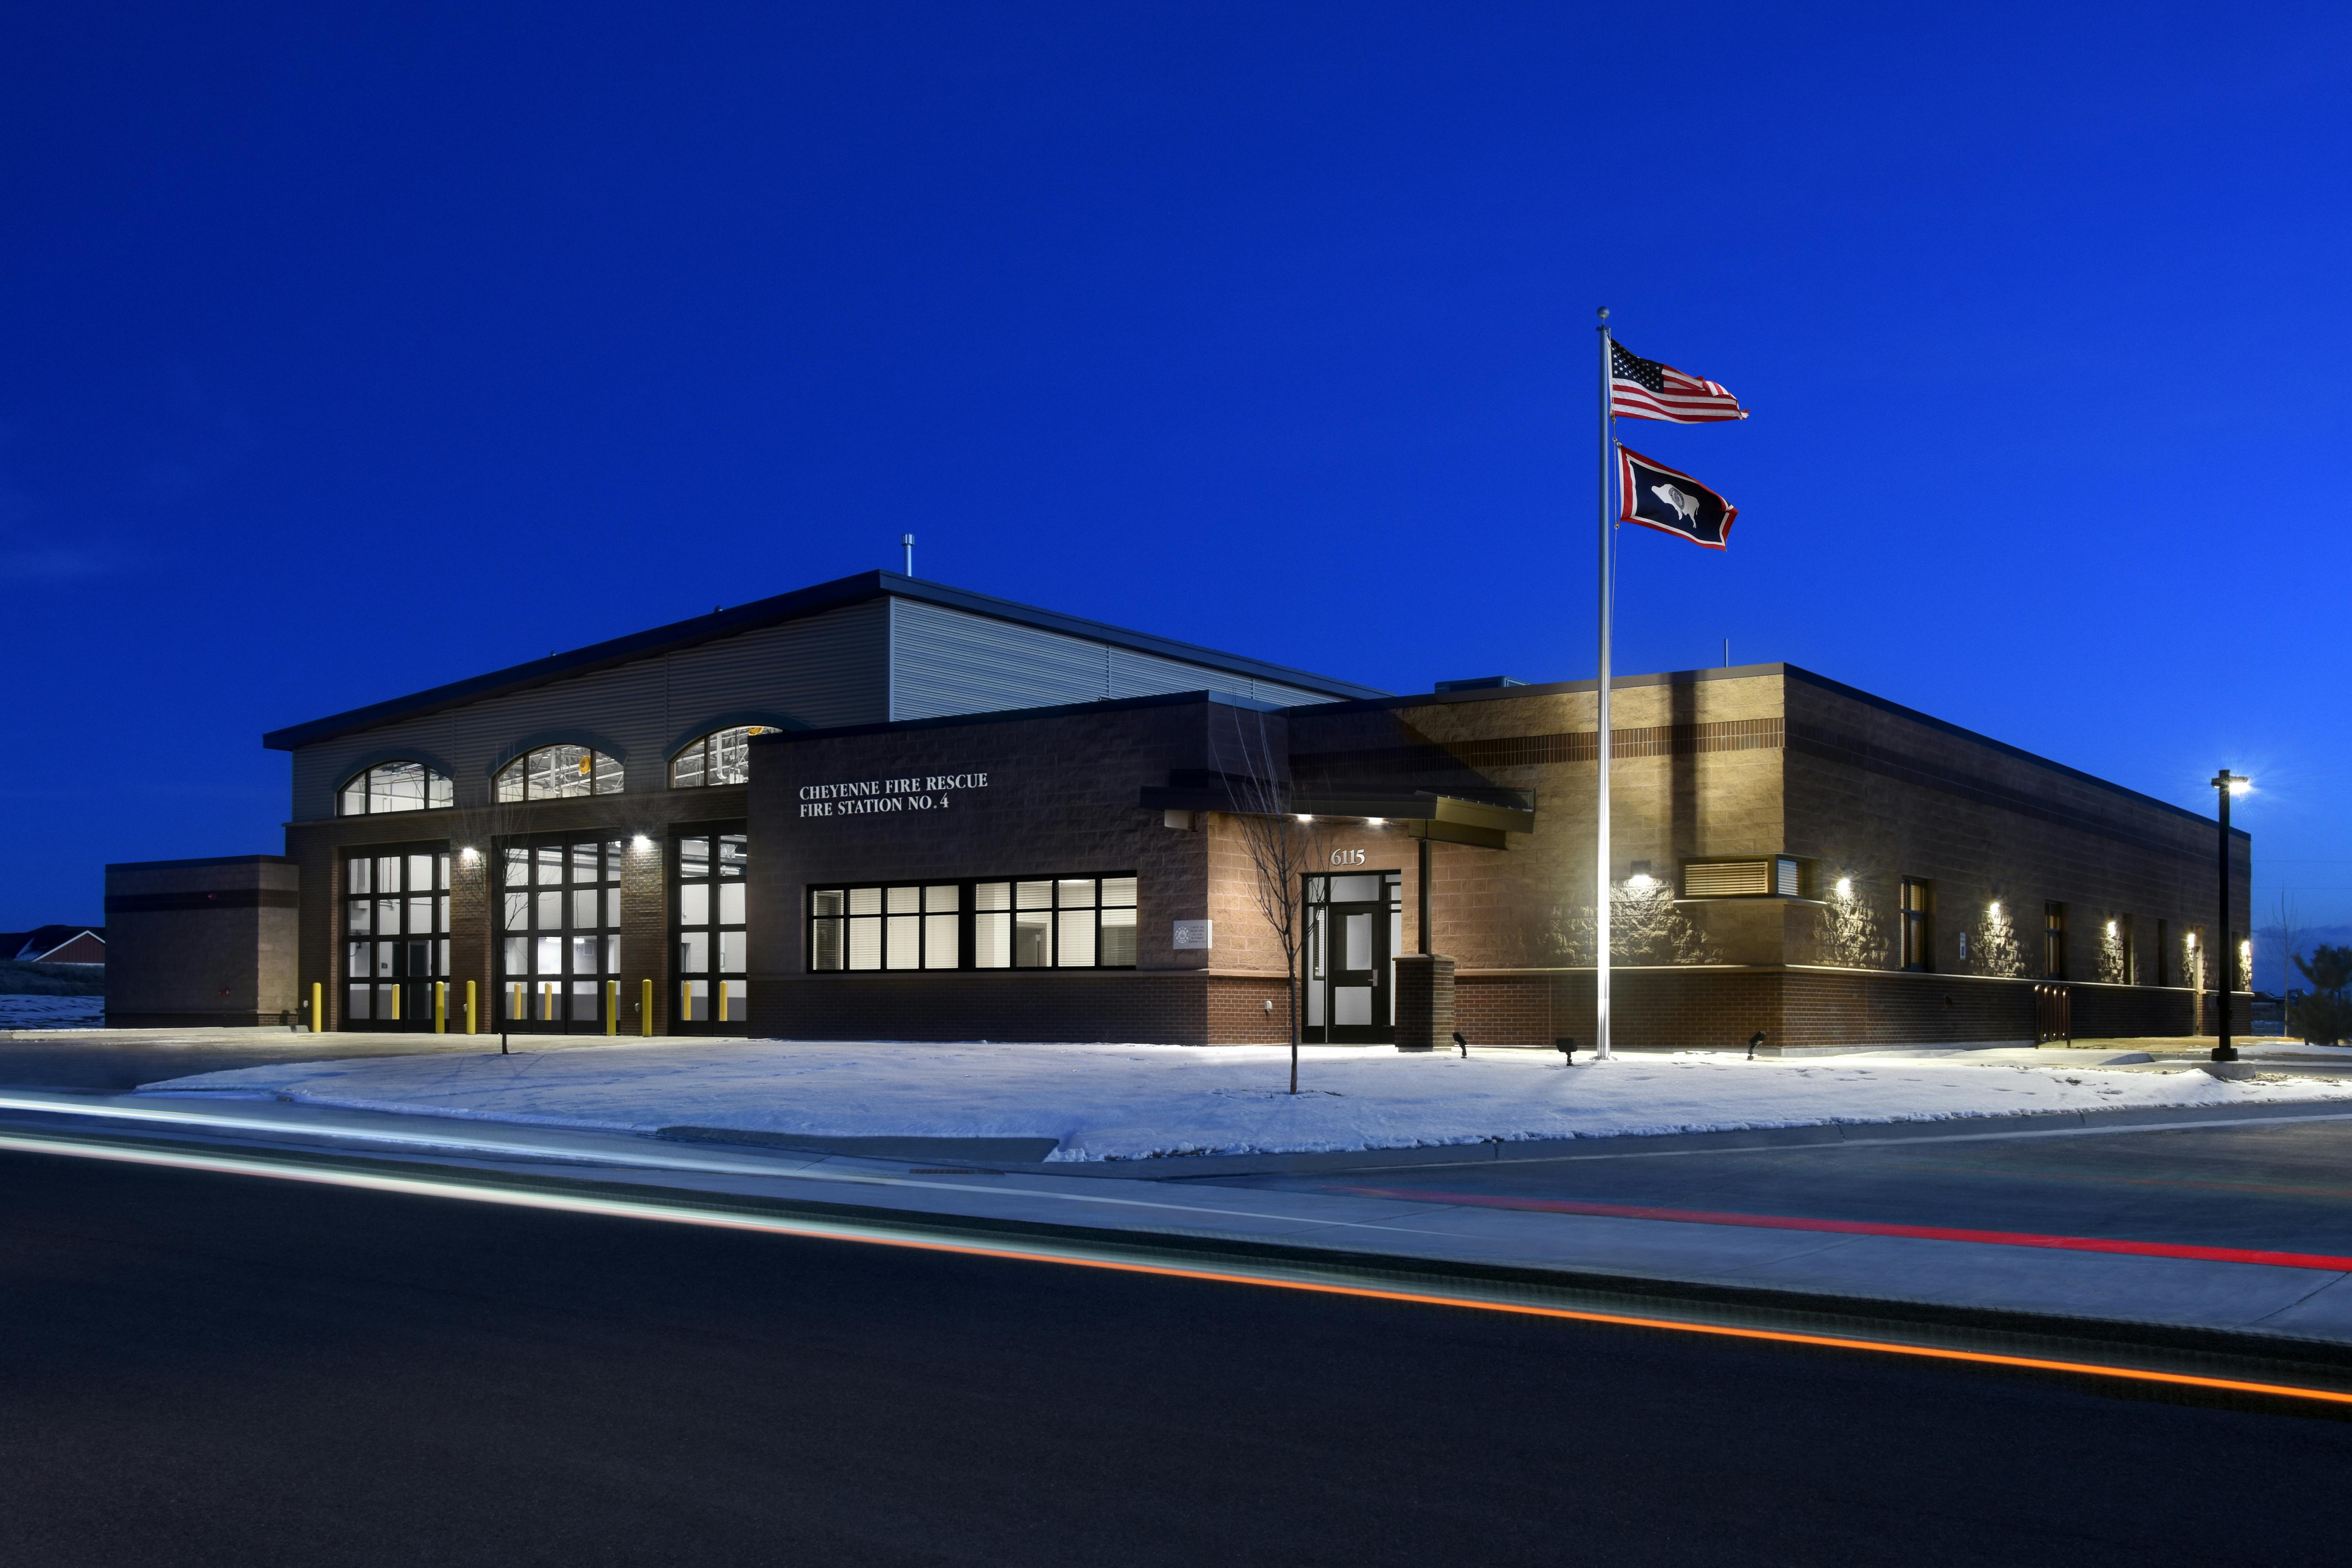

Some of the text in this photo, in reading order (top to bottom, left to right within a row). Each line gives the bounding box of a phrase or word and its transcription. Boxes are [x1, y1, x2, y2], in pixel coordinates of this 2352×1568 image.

[799, 773, 988, 800] CHEYENNE FIRE RESCUE
[800, 802, 833, 817] FIRE
[838, 797, 902, 815] STATION
[1331, 848, 1365, 866] 6115
